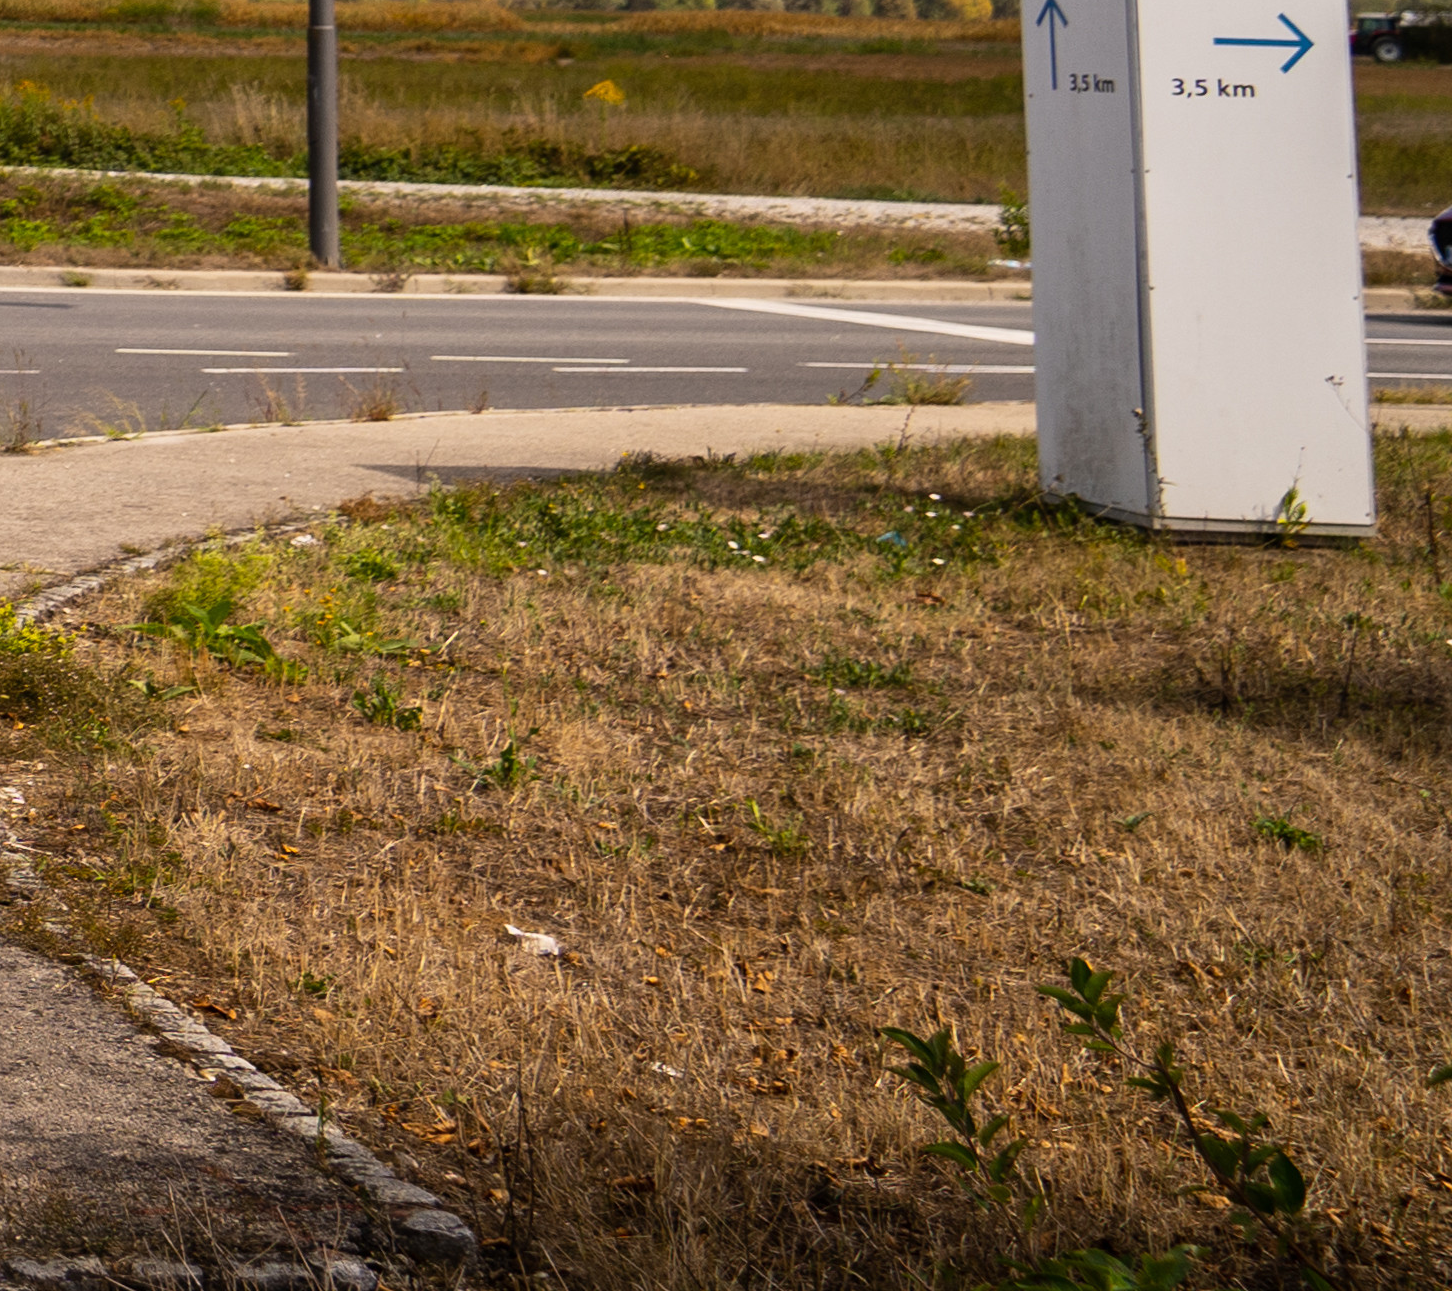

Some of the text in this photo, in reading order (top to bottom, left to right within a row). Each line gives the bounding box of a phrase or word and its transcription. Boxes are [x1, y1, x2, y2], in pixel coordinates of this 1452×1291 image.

[1069, 73, 1115, 93] 3,5 km
[1171, 78, 1256, 98] 3,5 km
